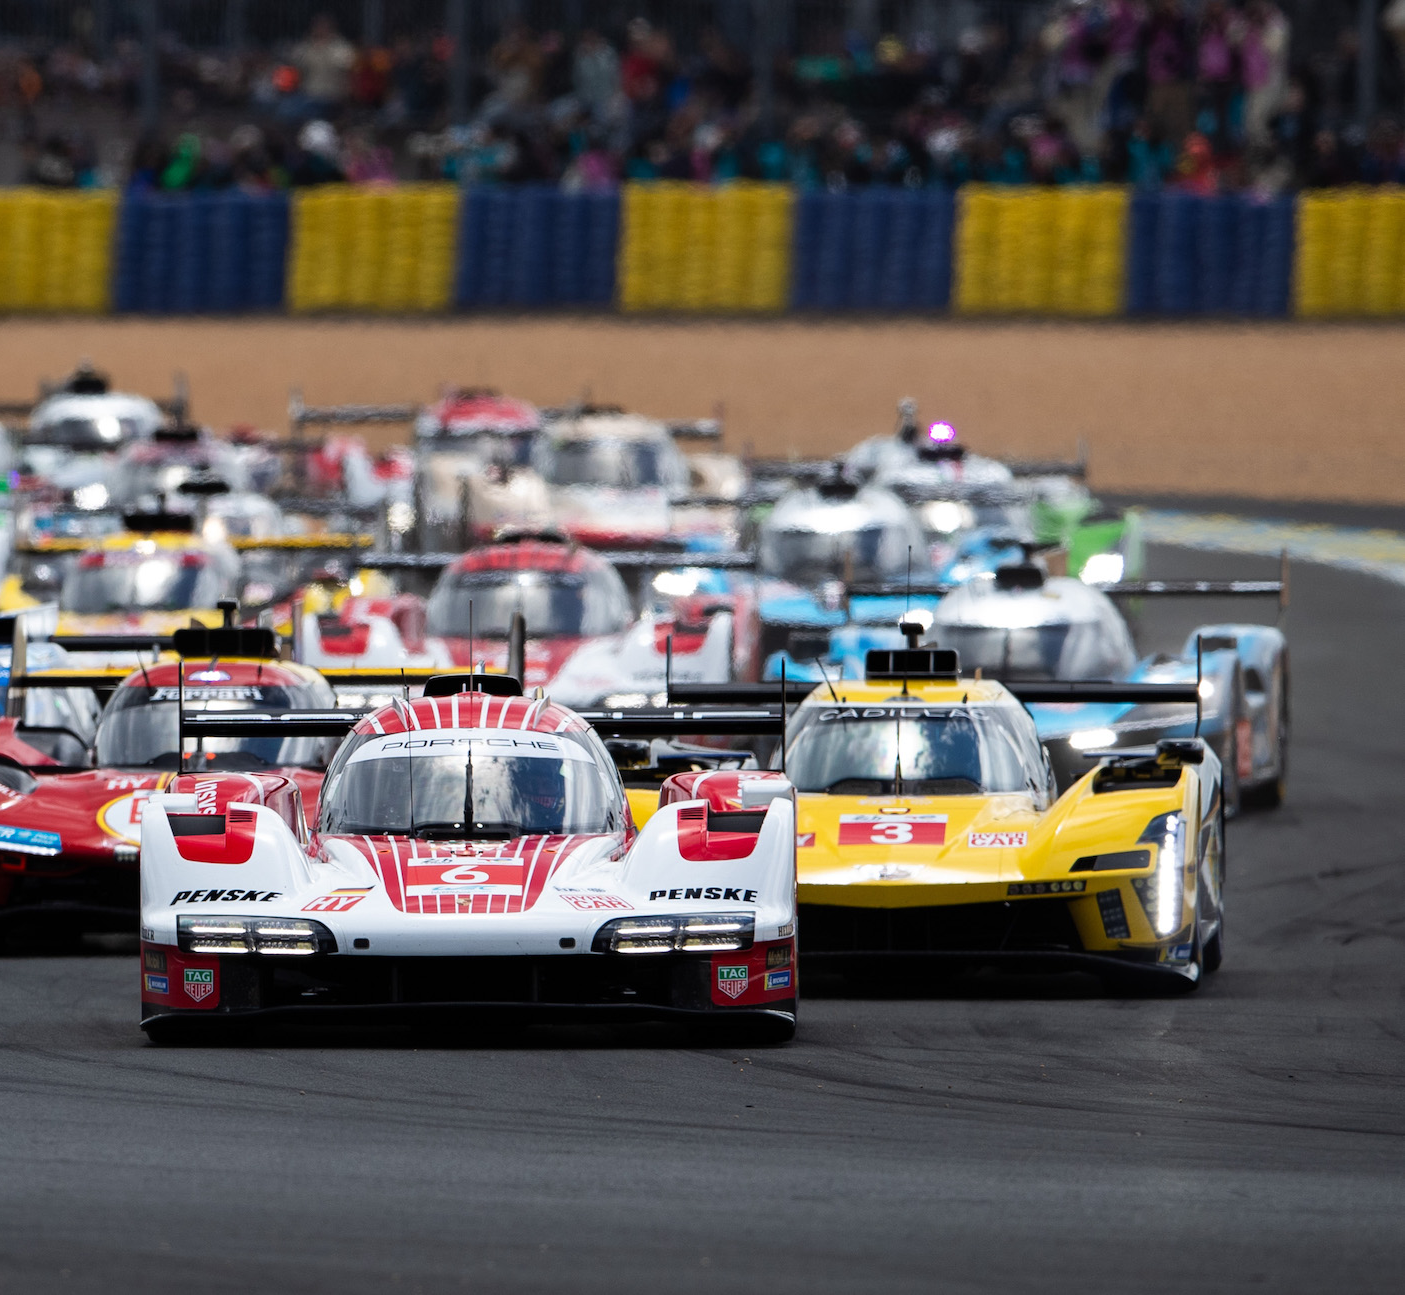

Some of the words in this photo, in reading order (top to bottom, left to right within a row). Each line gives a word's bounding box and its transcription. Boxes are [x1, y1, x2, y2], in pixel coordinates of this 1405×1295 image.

[149, 686, 264, 701] Ferrari
[819, 708, 990, 722] CADILLAC
[381, 738, 559, 752] PORSCHE
[107, 777, 146, 791] HY
[870, 822, 914, 844] 3
[971, 838, 1024, 846] CAR
[440, 864, 490, 884] 6
[169, 889, 283, 906] PENSKE
[649, 887, 758, 903] PENSKE
[305, 896, 360, 911] HY
[574, 900, 628, 909] CAR
[187, 971, 211, 982] TAG
[721, 968, 746, 978] TAG
[185, 983, 212, 999] HEUER
[720, 980, 747, 996] HEUER
